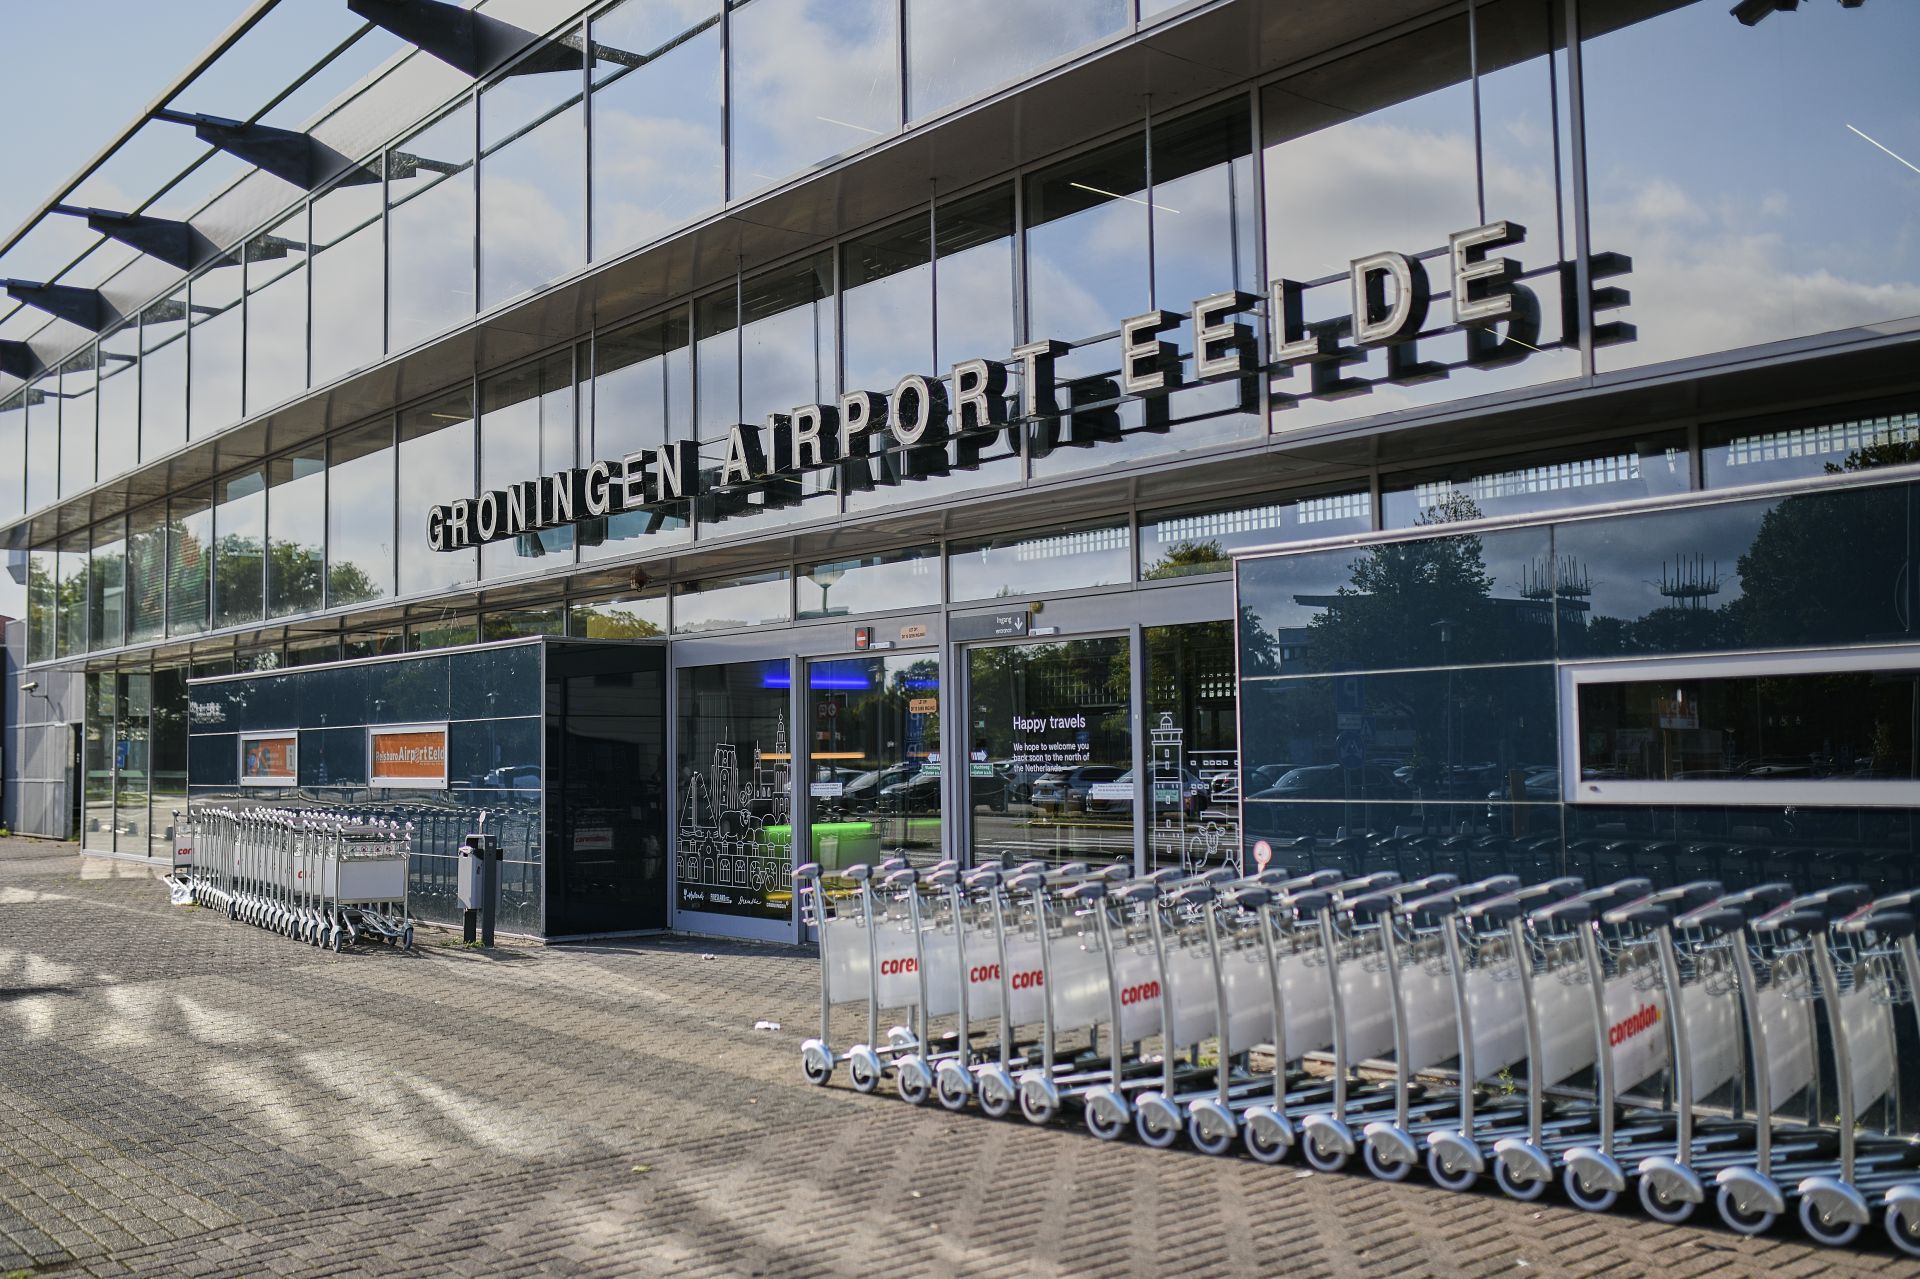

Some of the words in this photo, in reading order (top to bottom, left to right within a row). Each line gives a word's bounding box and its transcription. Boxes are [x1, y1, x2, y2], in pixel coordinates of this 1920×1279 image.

[427, 440, 684, 551] GRONINGEN
[719, 339, 1052, 487] AIRPORT
[1120, 220, 1514, 395] EELDE
[1013, 715, 1046, 733] Happy
[1049, 713, 1086, 729] travels
[1013, 742, 1023, 751] We
[1024, 742, 1040, 752] hope
[1041, 742, 1048, 751] to
[1049, 742, 1076, 751] welcome
[1077, 743, 1090, 752] you
[1029, 754, 1044, 762] soon
[1045, 753, 1052, 761] to
[1053, 752, 1064, 761] the
[1064, 752, 1082, 761] north
[1082, 752, 1090, 761] of
[1013, 763, 1024, 772] the
[970, 964, 1000, 983] core
[1012, 970, 1044, 990] core
[1121, 980, 1161, 1006] coren
